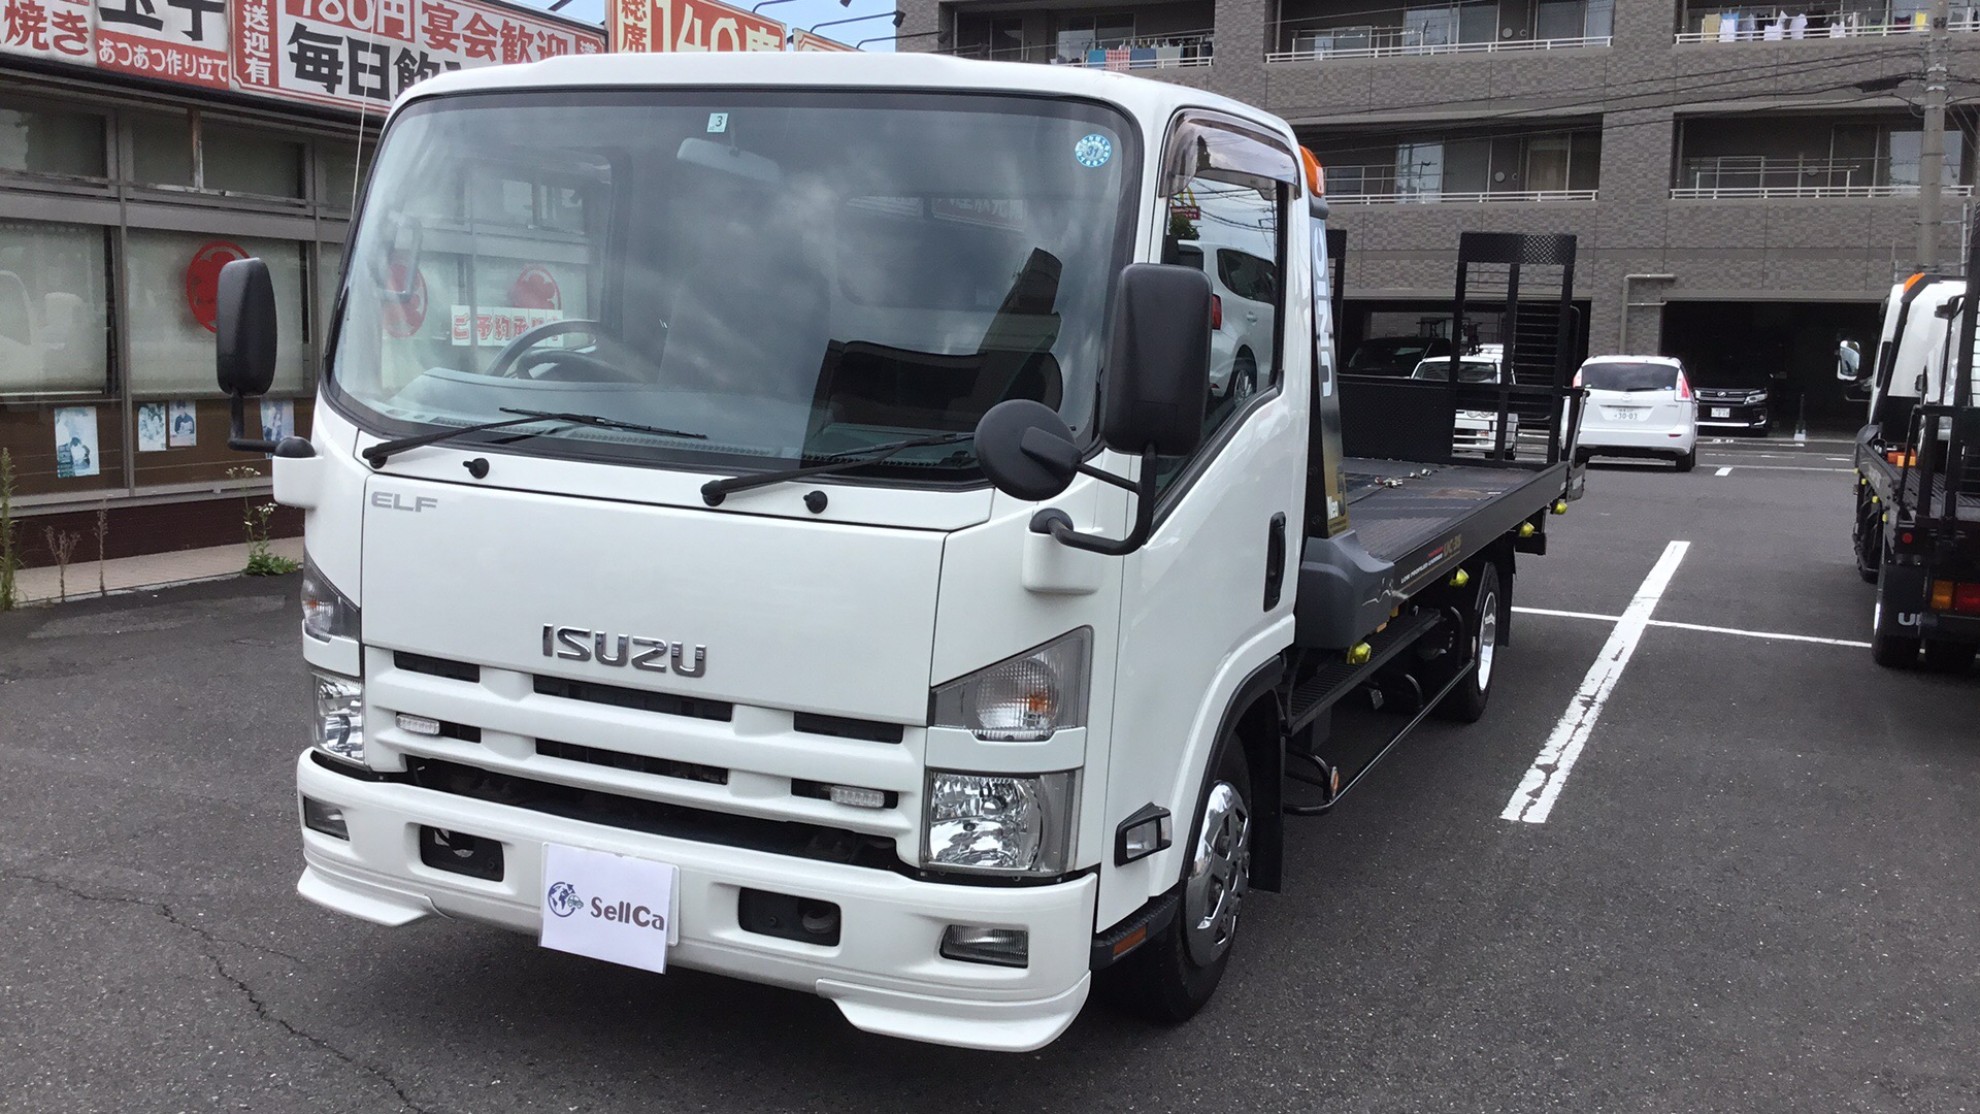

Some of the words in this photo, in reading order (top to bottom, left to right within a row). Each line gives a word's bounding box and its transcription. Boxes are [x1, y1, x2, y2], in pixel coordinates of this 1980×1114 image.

[98, 38, 228, 83] あつあつ作り立て
[243, 0, 271, 86] 送迎有
[715, 115, 723, 127] 3
[371, 491, 438, 513] ELF
[542, 623, 706, 678] ISUZU
[590, 896, 665, 931] SellCa
